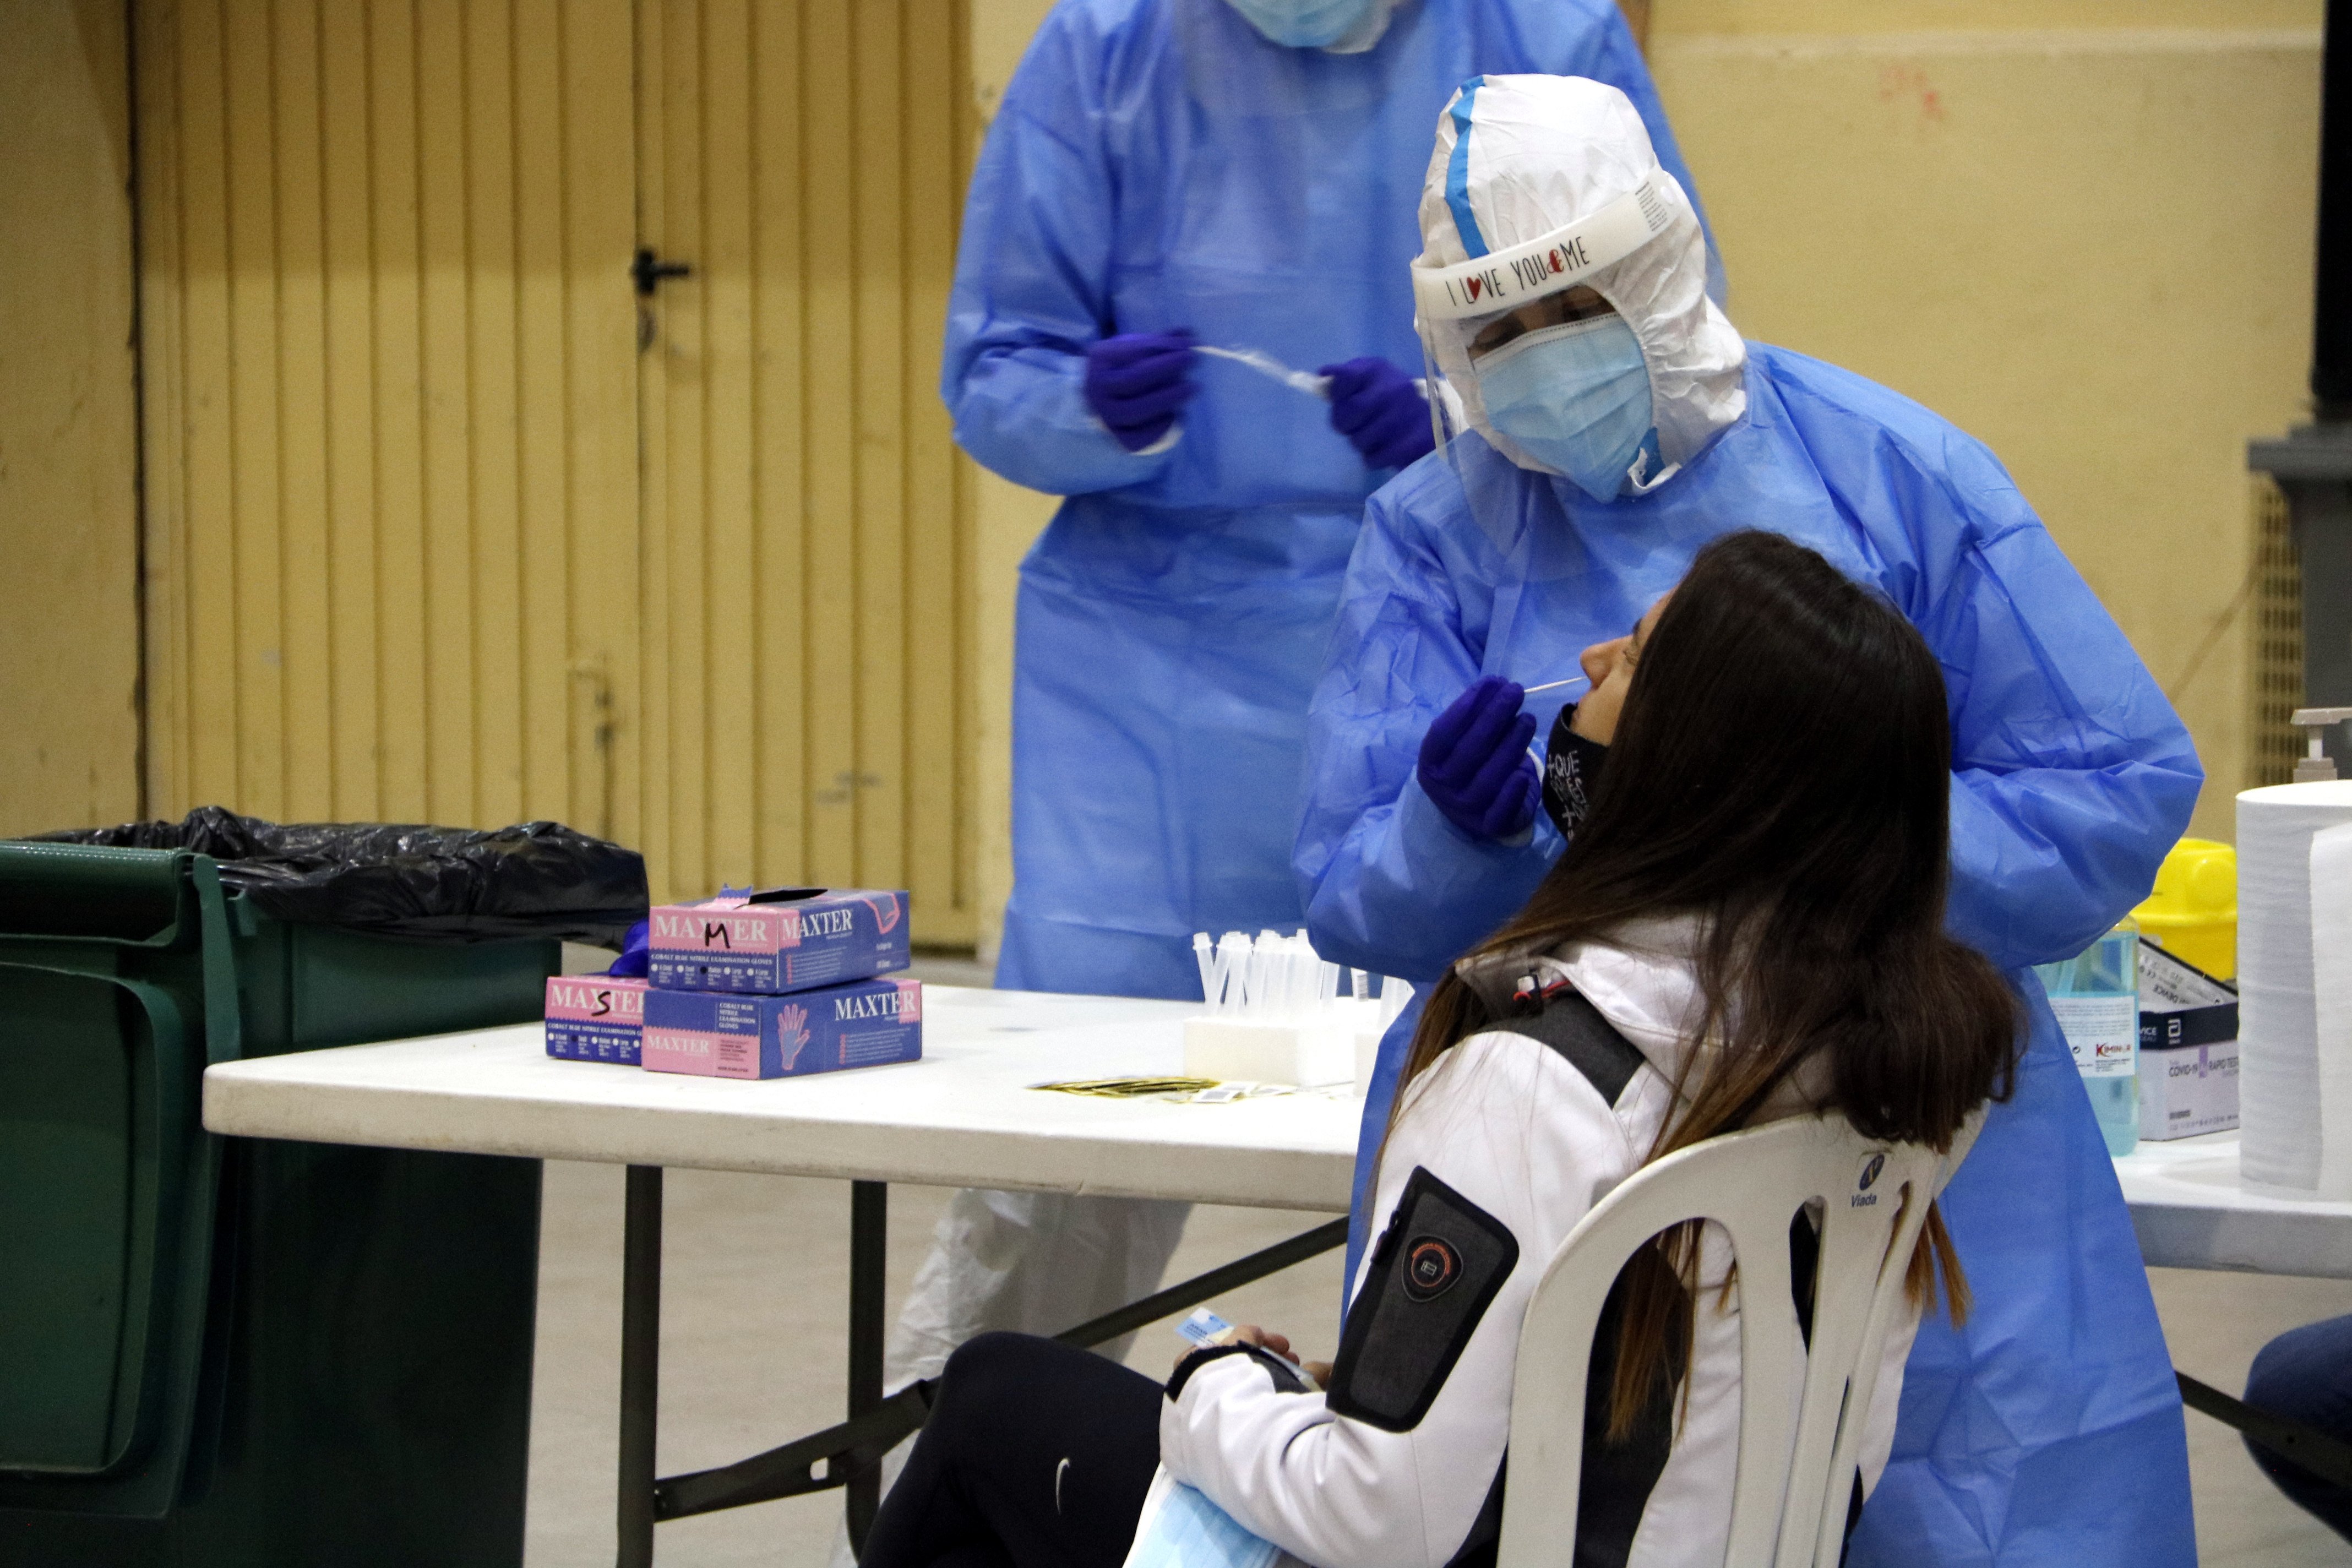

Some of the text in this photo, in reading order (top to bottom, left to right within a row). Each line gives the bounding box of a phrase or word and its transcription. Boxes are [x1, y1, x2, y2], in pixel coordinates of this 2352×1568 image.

[1445, 280, 1457, 306] I
[655, 915, 767, 942] MAXTER
[704, 922, 731, 949] M
[782, 909, 853, 940] MAXTER
[591, 990, 611, 1016] S
[835, 990, 916, 1021] MAXTER
[647, 1035, 709, 1054] MAXTER
[1851, 1193, 1877, 1207] Viada
